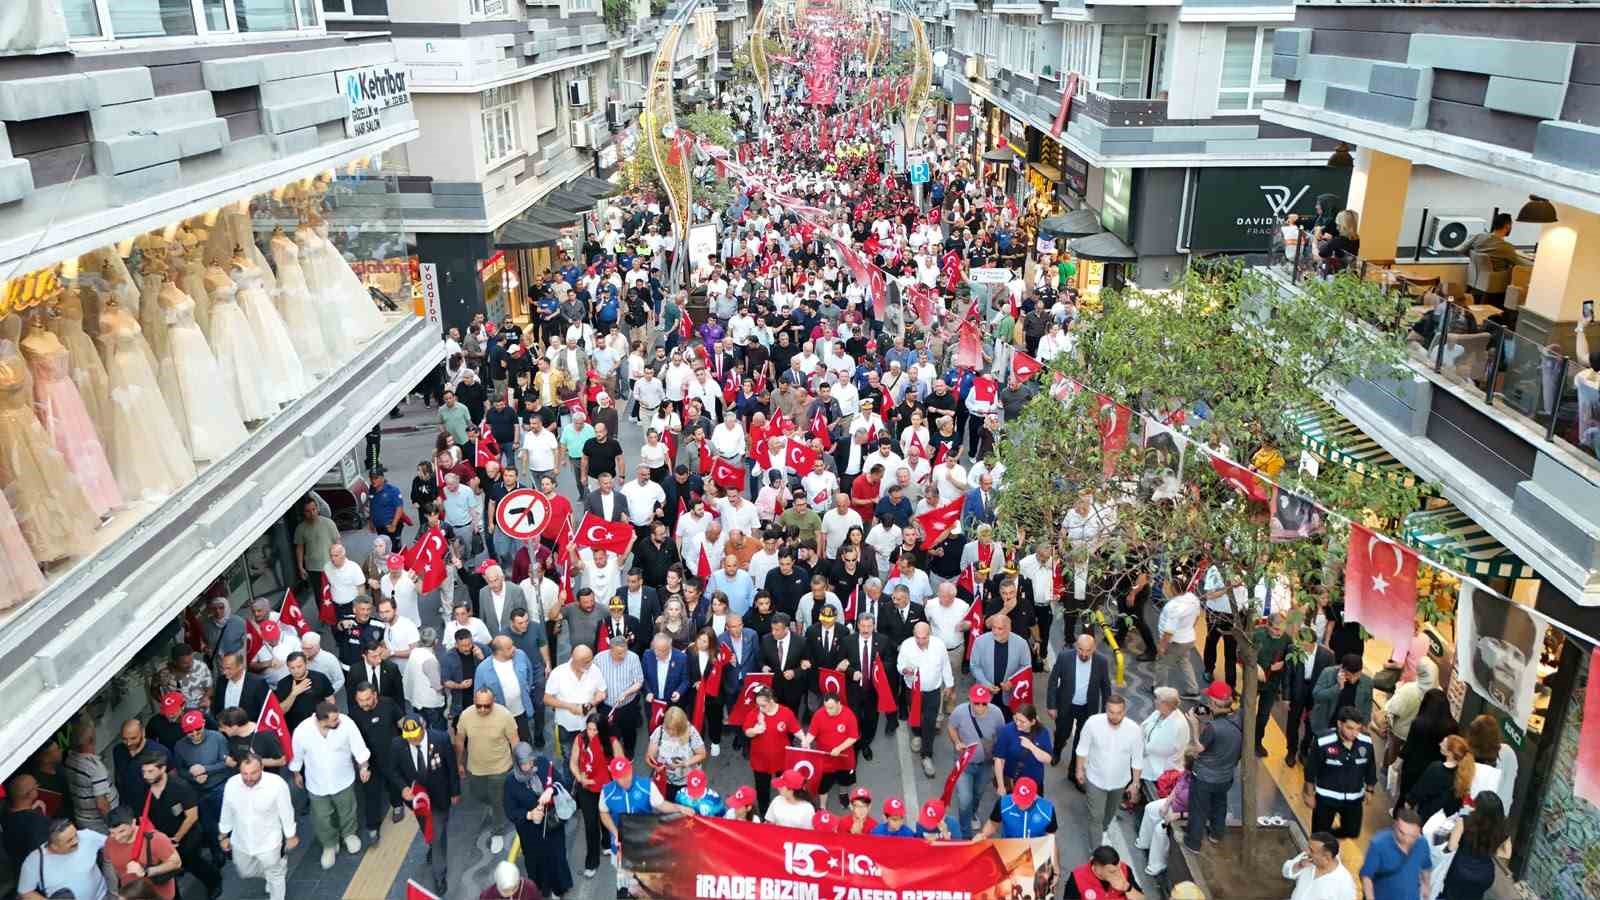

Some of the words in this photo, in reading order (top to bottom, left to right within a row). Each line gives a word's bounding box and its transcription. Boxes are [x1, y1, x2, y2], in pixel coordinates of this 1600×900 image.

[358, 68, 406, 101] Kehribar
[1236, 217, 1273, 226] DAVID
[759, 877, 824, 900] BİZİM
